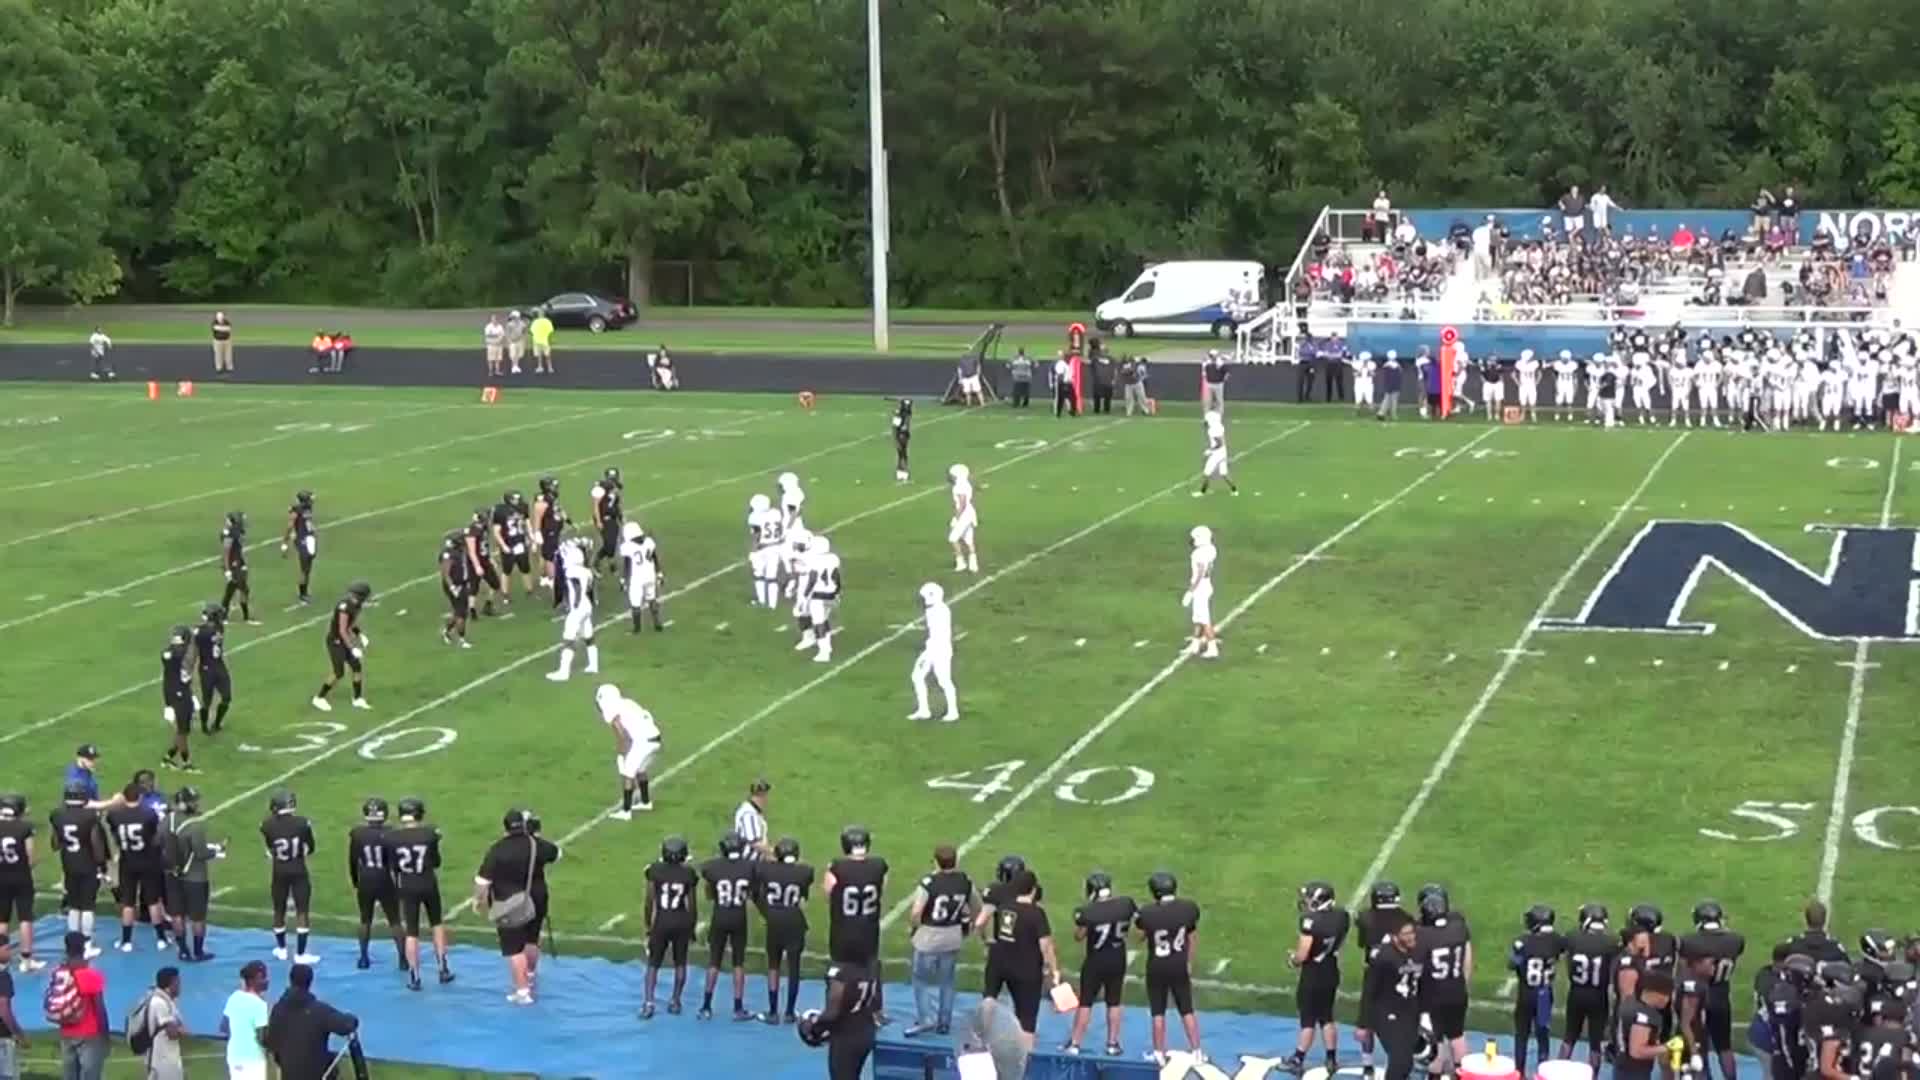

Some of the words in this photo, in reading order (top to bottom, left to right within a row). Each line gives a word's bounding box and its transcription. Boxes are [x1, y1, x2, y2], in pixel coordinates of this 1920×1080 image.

[237, 721, 458, 759] 30
[925, 760, 1155, 805] 40
[62, 824, 81, 853] 5
[117, 823, 146, 852] 15
[273, 836, 300, 861] 21
[362, 844, 383, 869] 11
[395, 845, 428, 874] 27
[660, 882, 685, 910] 17
[767, 881, 801, 907] 20
[842, 884, 878, 916] 62
[931, 894, 966, 922] 67
[1430, 946, 1462, 979] 51
[1571, 953, 1602, 987] 31
